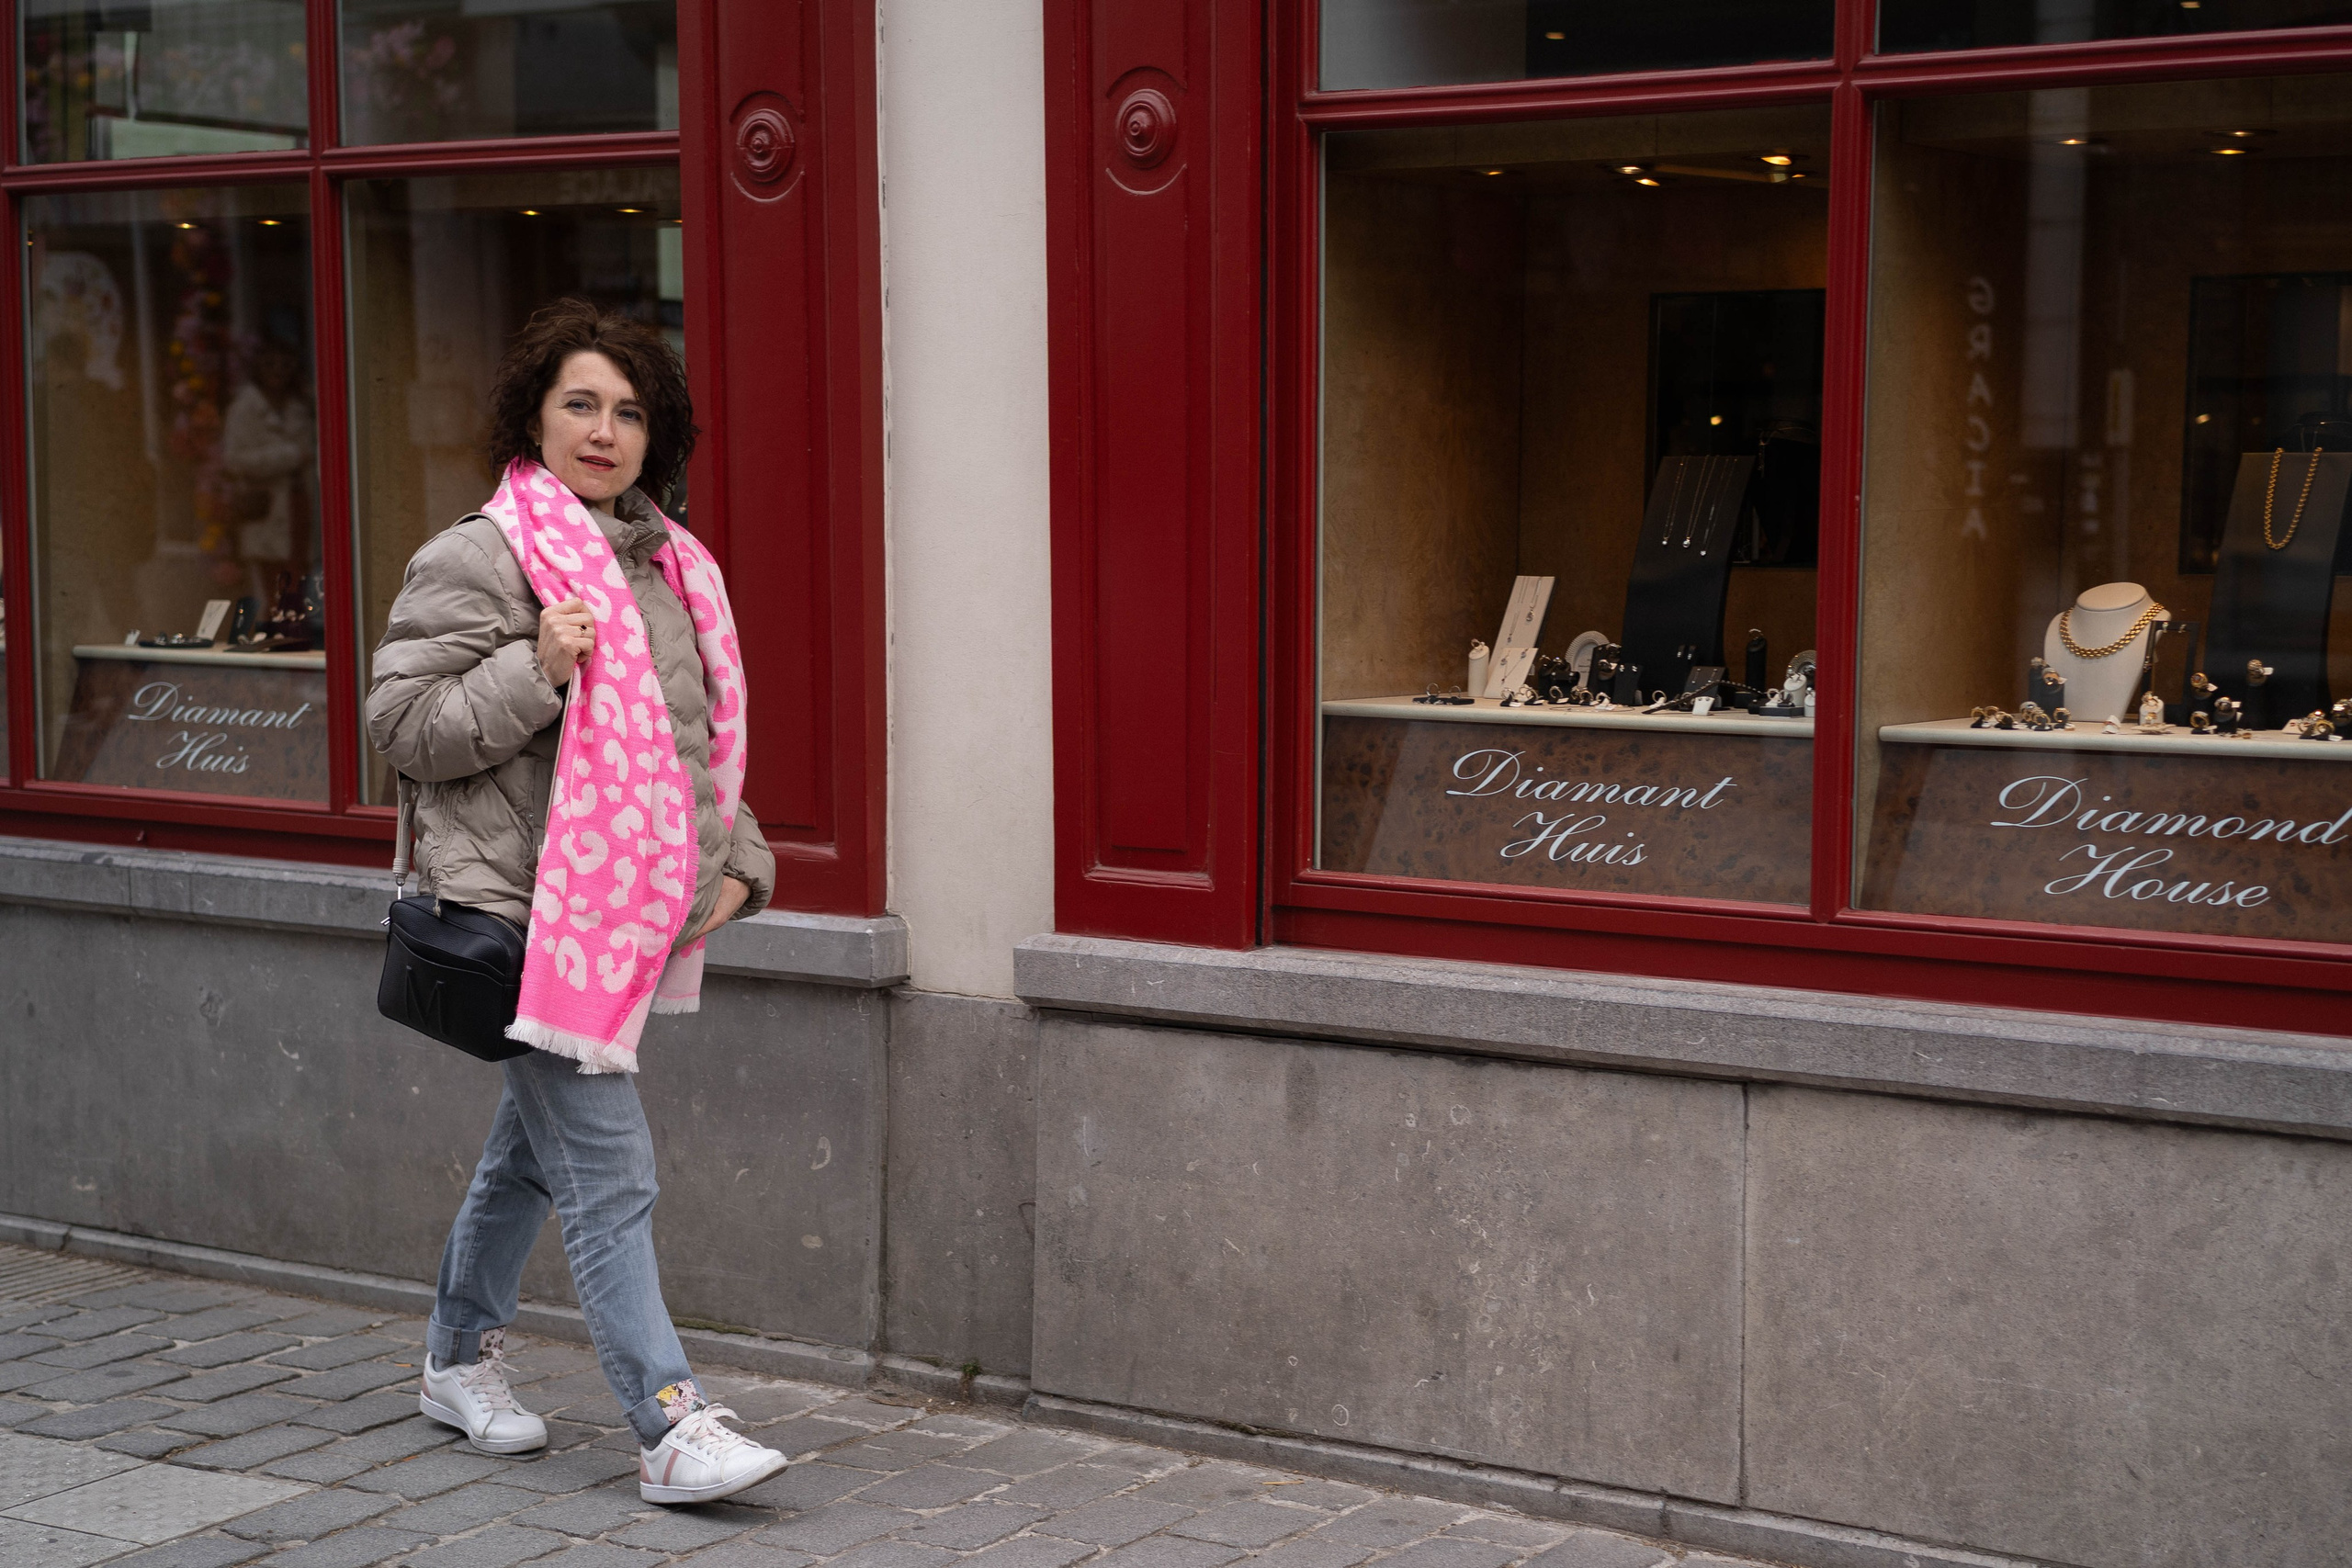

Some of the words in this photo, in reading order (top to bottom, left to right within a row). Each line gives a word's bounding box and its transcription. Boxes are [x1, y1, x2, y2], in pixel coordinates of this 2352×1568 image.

[128, 681, 311, 729] Diamant
[156, 730, 250, 773] Huis
[1445, 749, 1737, 809] Diamant
[1499, 811, 1648, 865] Huis
[1990, 775, 2352, 844] Diamond
[2043, 843, 2271, 908] House
